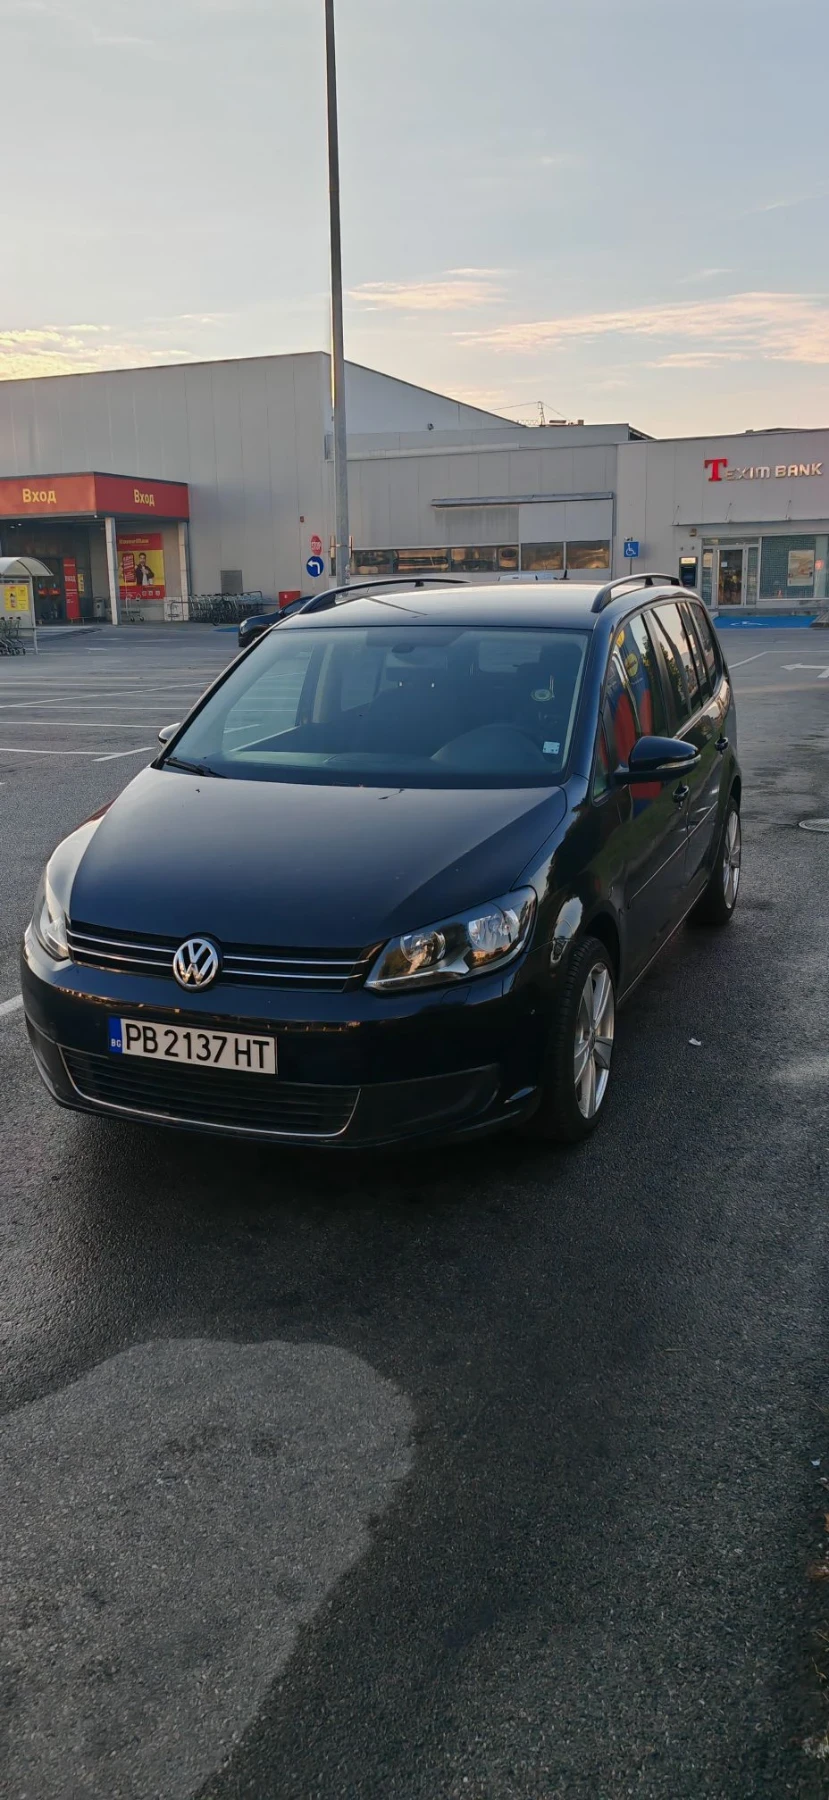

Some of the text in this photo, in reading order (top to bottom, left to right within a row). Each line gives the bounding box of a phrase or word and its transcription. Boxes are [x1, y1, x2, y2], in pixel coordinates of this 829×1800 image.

[704, 458, 823, 482] TEXIM BANK
[22, 488, 57, 504] Вход
[134, 489, 155, 507] Вход
[311, 542, 322, 550] STOP
[174, 939, 218, 986] VW
[110, 1038, 122, 1048] BG
[125, 1023, 270, 1069] PB 2137 HT
